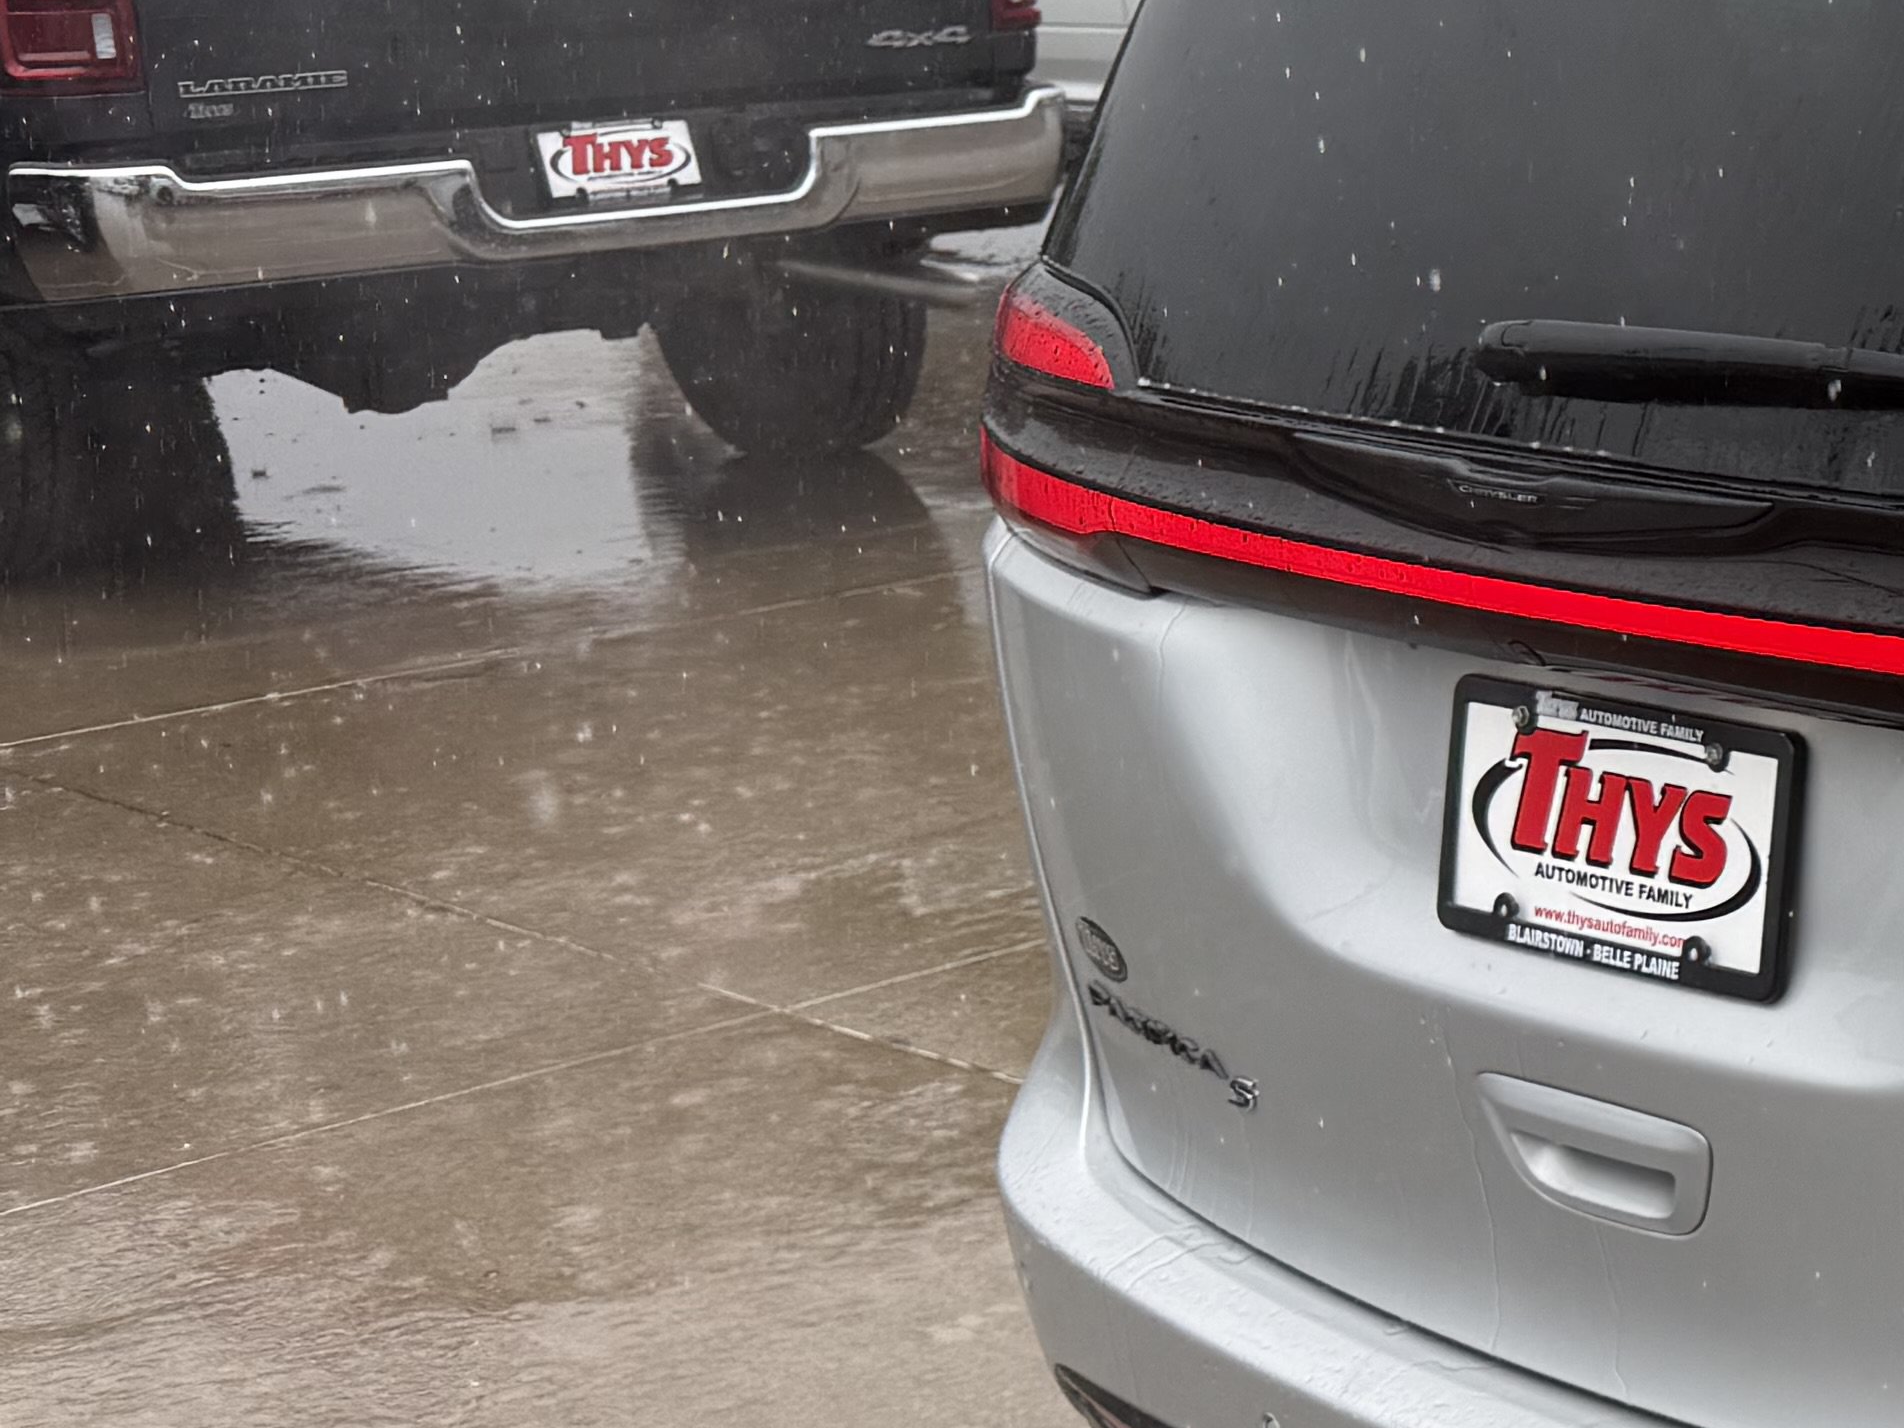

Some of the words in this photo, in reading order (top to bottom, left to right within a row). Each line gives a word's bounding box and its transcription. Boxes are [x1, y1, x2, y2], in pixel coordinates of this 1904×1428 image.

[867, 25, 972, 48] 4x4
[177, 70, 348, 99] LARAMIE
[562, 133, 674, 176] THYS
[1459, 485, 1538, 503] CHRYSLER
[1579, 708, 1659, 735] AUTOMOTIVE
[1660, 723, 1705, 743] FAMILY
[1509, 726, 1733, 890] THYS
[1534, 861, 1635, 898] AUTOMOTIVE
[1637, 882, 1694, 910] FAMILY
[1507, 923, 1585, 959] BLAIRSTOWN
[1592, 943, 1632, 970] BELLE
[1632, 952, 1681, 981] PLAINE
